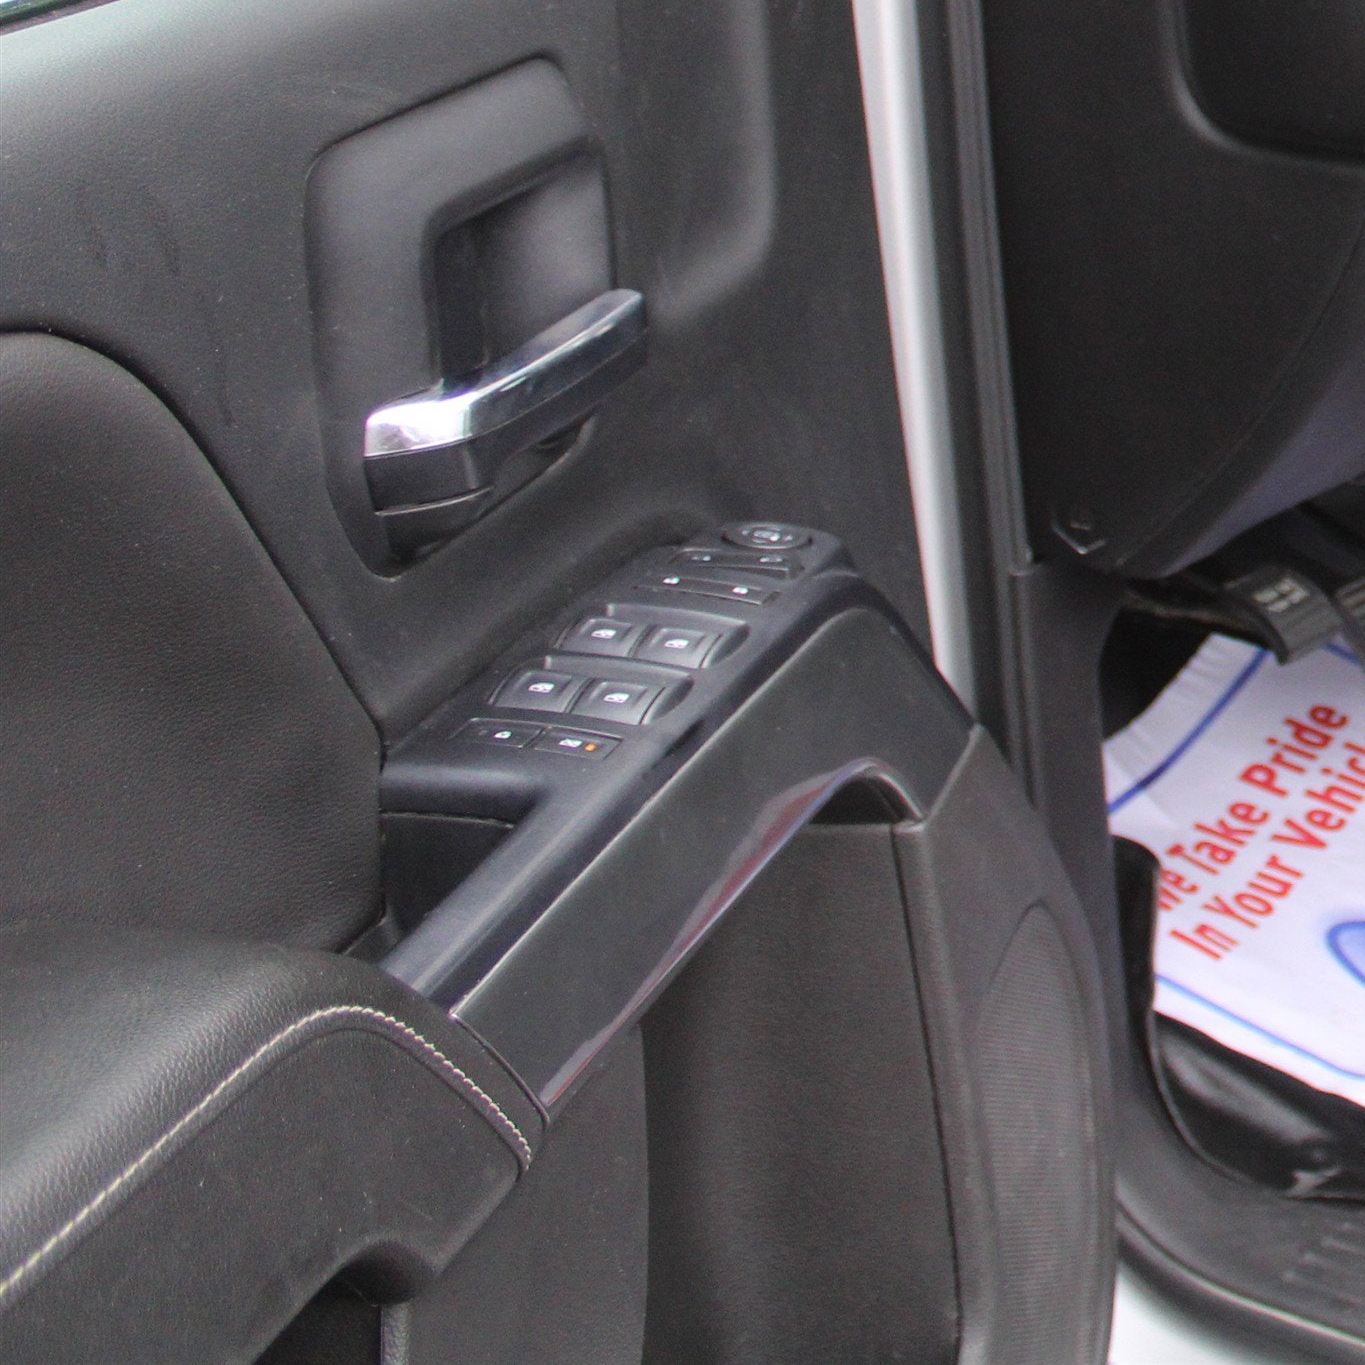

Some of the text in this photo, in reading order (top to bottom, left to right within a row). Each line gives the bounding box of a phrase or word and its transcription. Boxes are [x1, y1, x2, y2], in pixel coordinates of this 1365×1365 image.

[1166, 801, 1269, 875] Take
[1240, 704, 1348, 797] Pride
[1202, 855, 1304, 929] Your
[1171, 924, 1240, 961] In
